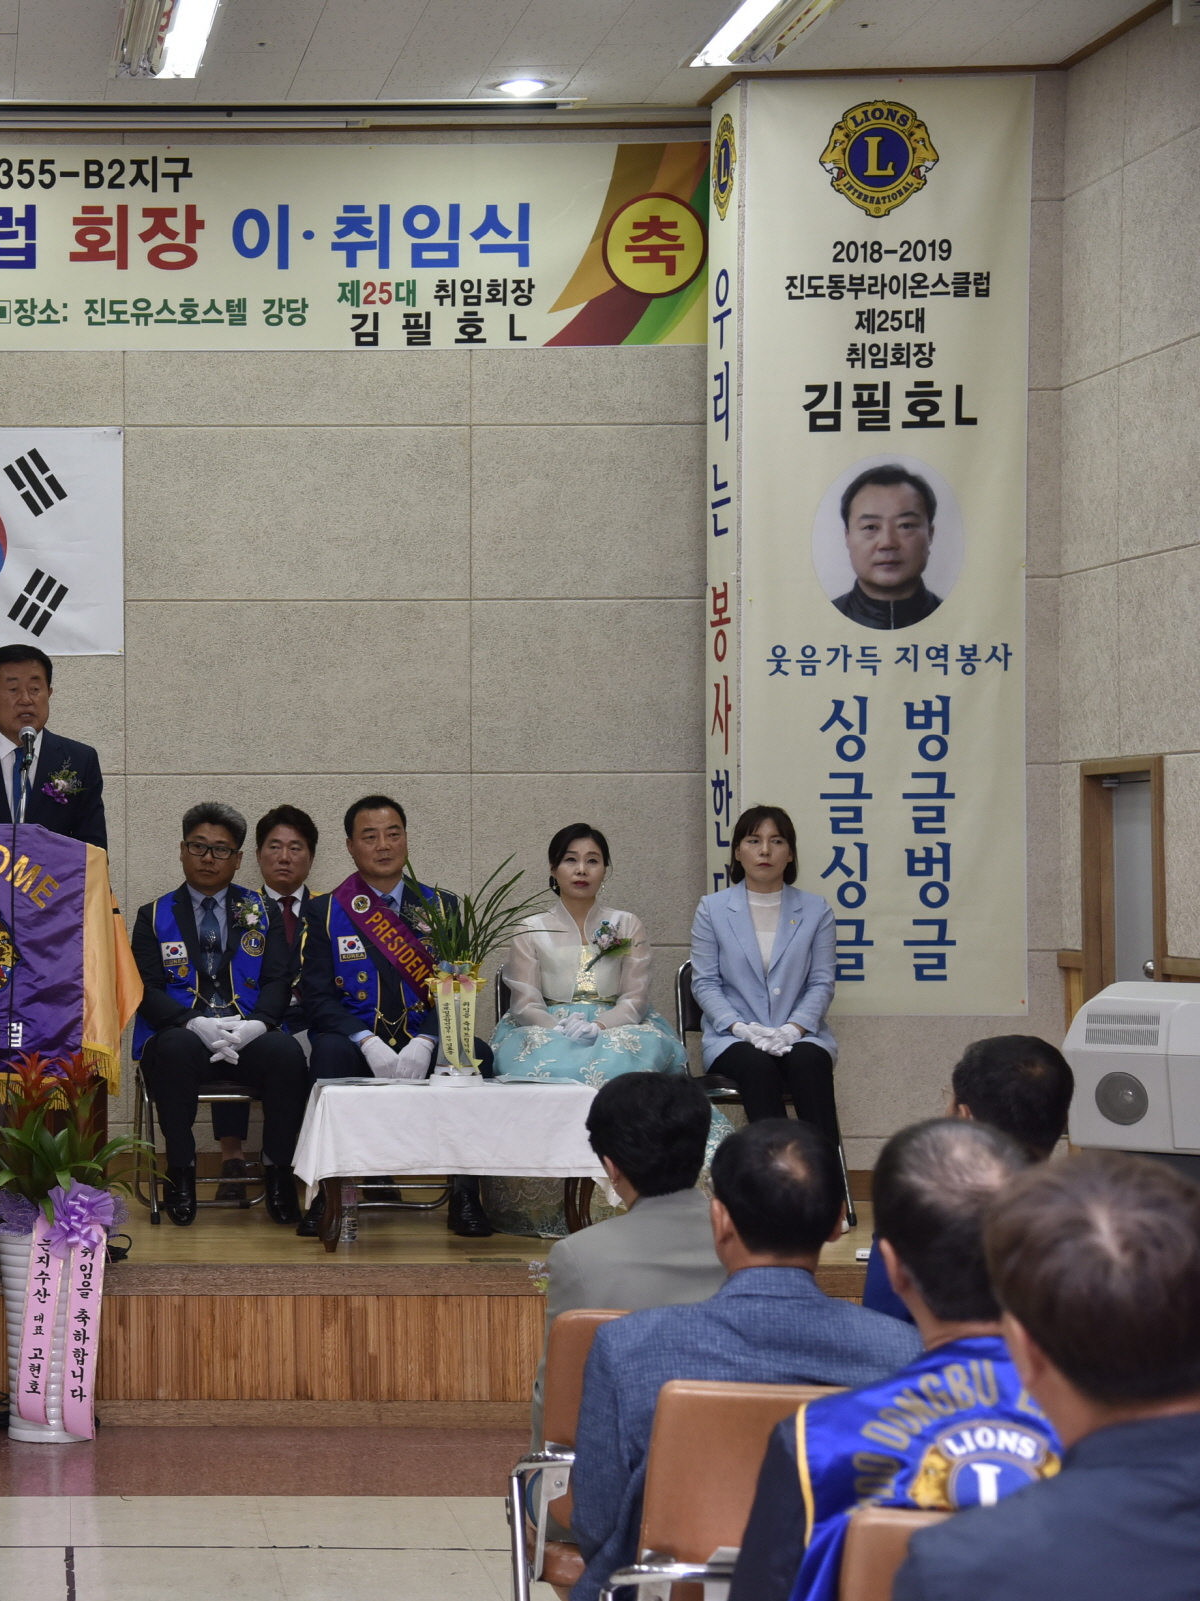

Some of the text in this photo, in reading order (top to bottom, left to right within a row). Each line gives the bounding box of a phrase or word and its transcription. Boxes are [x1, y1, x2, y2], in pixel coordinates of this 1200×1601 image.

[850, 107, 910, 129] LIONS
[863, 136, 895, 177] L
[843, 181, 914, 206] INTERNATIONAL
[69, 204, 205, 270] 회장
[624, 215, 685, 276] 축
[832, 238, 952, 264] 2018-2019
[337, 277, 536, 308] 제25대 취임회장
[784, 271, 991, 301] 진도동부라이온스클럽
[84, 297, 248, 327] 진도유스호스텔
[261, 297, 309, 327] 강당
[854, 307, 926, 335] 제25대
[845, 341, 936, 369] 취임회장
[766, 642, 1013, 677] 웃음가득 지역봉사
[902, 695, 957, 982] 벙글벙글
[341, 952, 365, 960] KOREA
[31, 1313, 45, 1336] 대표
[70, 1308, 91, 1403] 축하합니다
[943, 1427, 1038, 1460] LIONS
